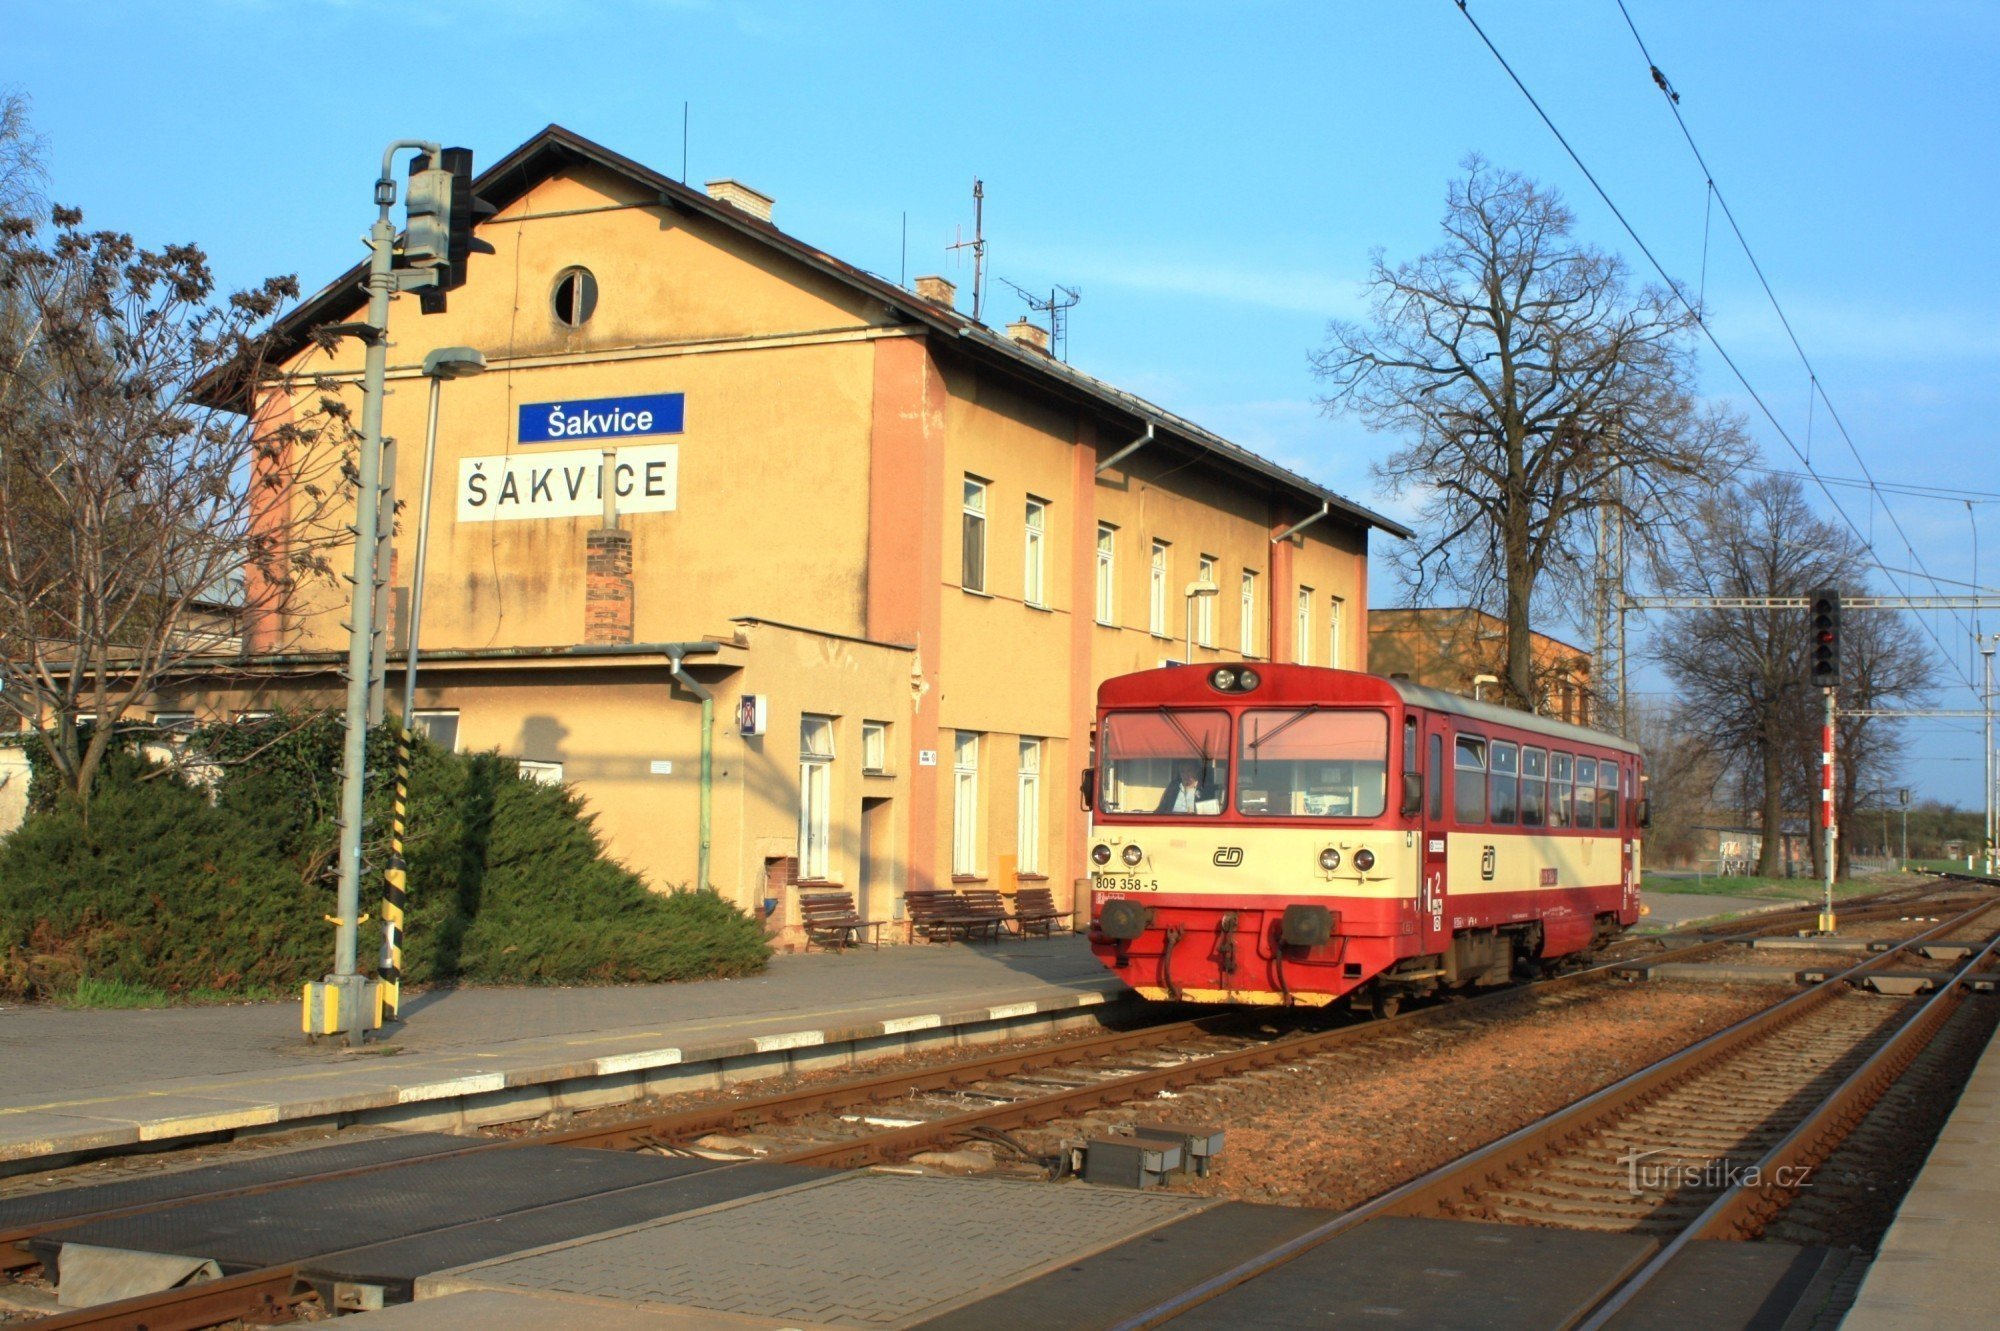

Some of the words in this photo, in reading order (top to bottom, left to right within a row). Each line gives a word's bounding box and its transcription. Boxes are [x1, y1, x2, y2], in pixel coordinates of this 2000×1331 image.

[547, 405, 653, 437] Šakvice
[467, 462, 667, 507] ŠAKVICE
[1096, 877, 1116, 889] 809
[1435, 871, 1441, 894] 2
